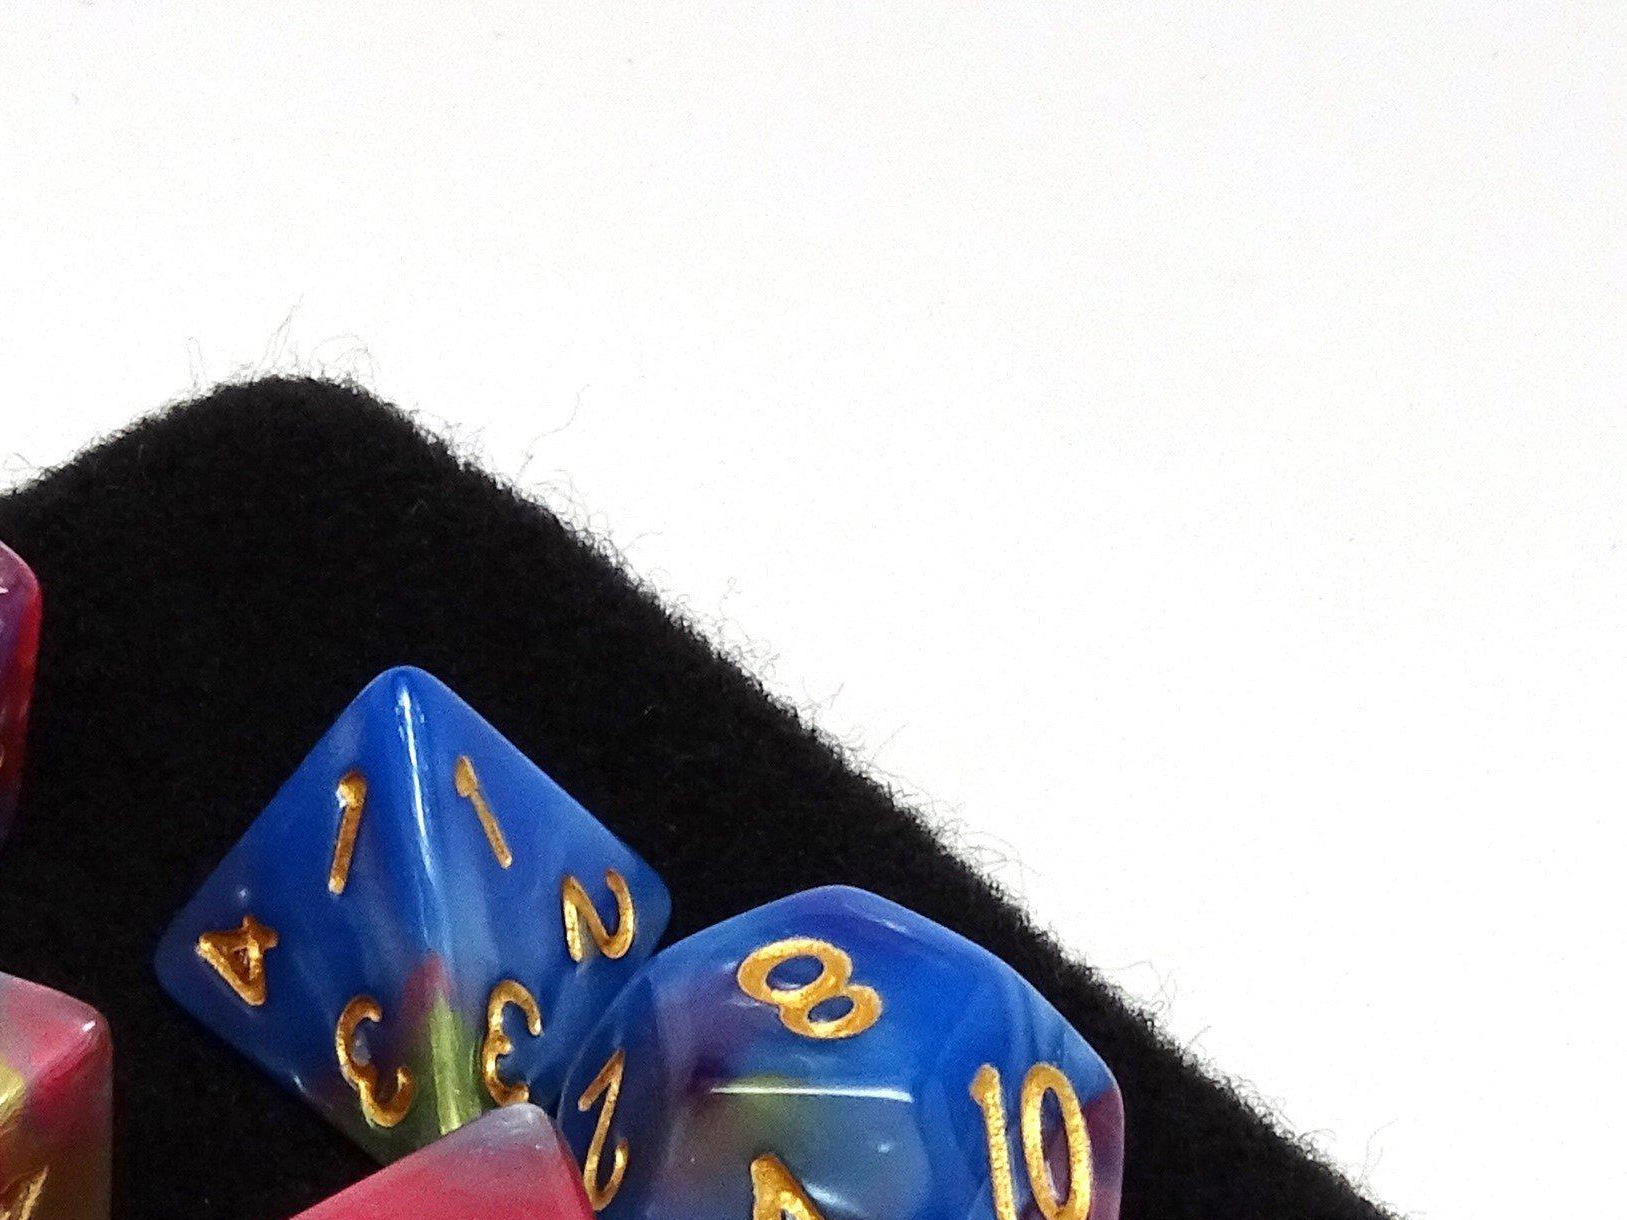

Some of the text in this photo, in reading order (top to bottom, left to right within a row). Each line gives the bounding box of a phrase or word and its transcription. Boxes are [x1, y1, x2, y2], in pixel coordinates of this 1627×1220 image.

[328, 769, 368, 896] 1
[454, 755, 513, 868] 1
[195, 914, 280, 1006] 4
[561, 867, 636, 963] 2
[482, 978, 542, 1107] 3
[735, 936, 883, 1040] 8
[335, 994, 414, 1128] 3
